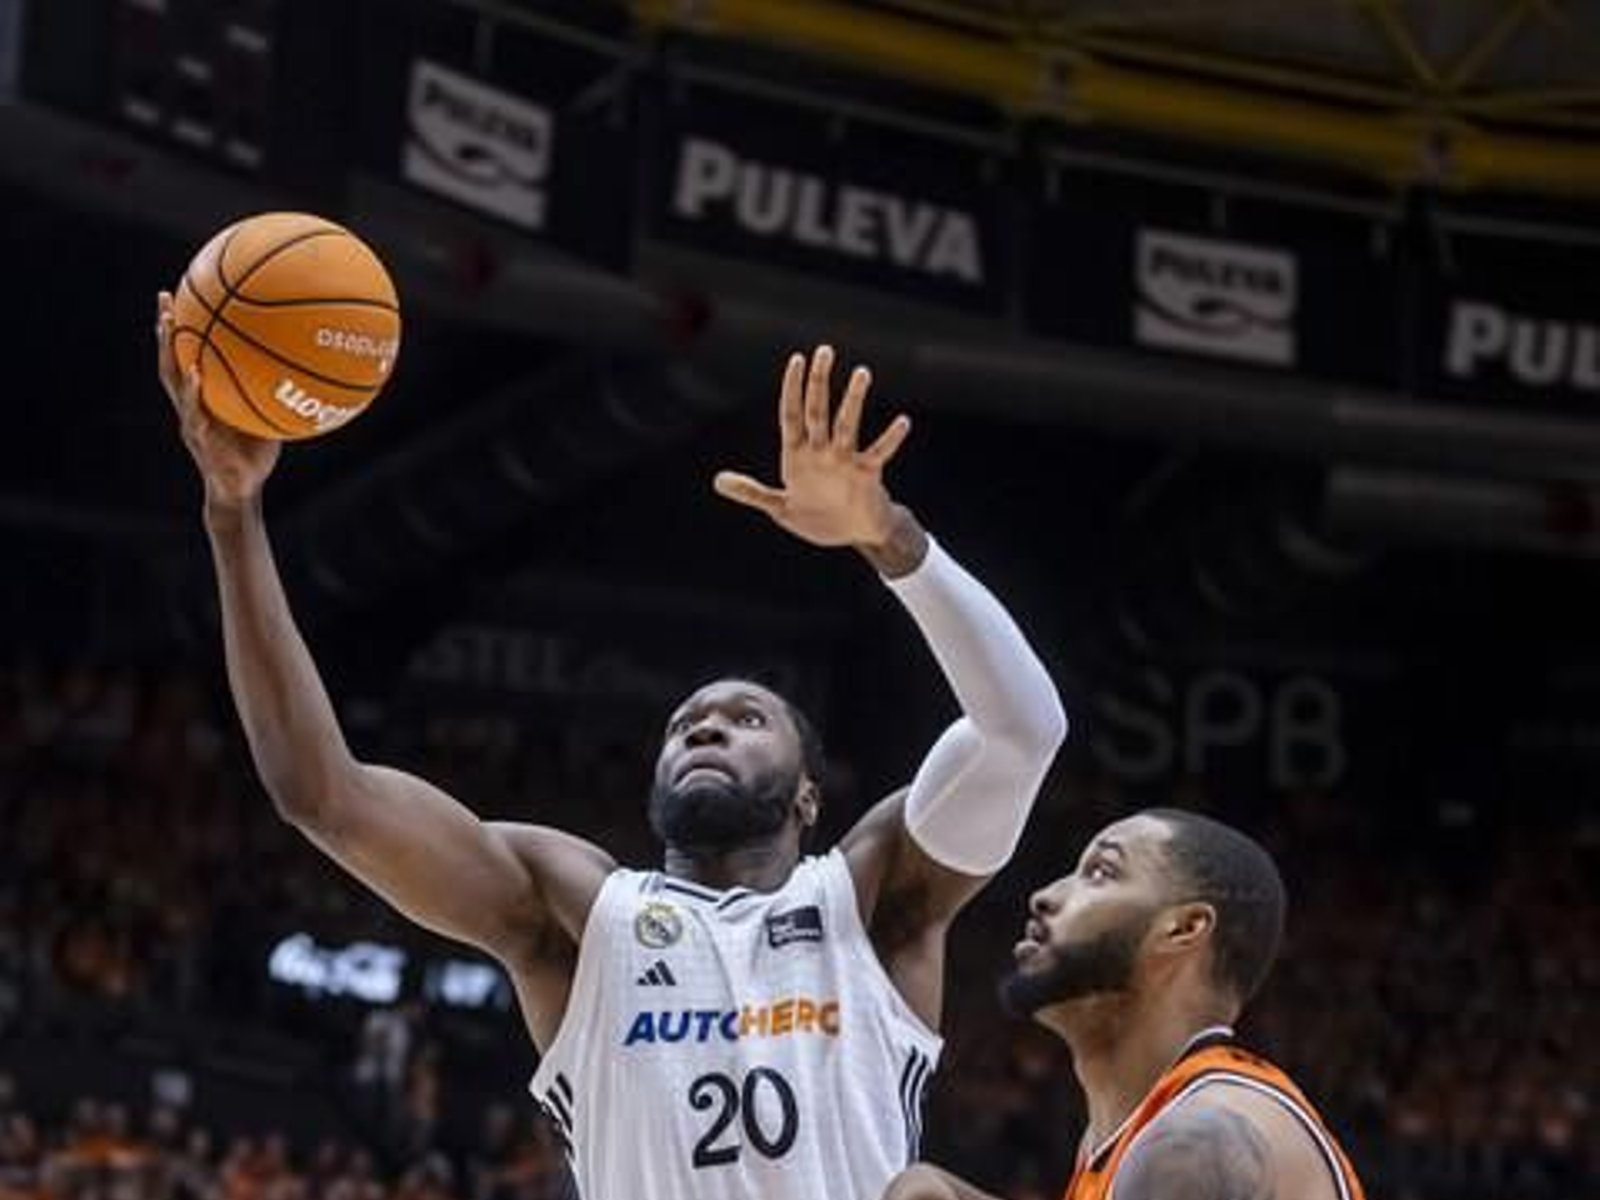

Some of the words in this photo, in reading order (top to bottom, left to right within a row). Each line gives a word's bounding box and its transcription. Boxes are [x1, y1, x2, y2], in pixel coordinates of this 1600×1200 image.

[674, 137, 985, 284] PULEVA
[1445, 300, 1600, 388] PUL
[688, 1066, 799, 1170] 20
